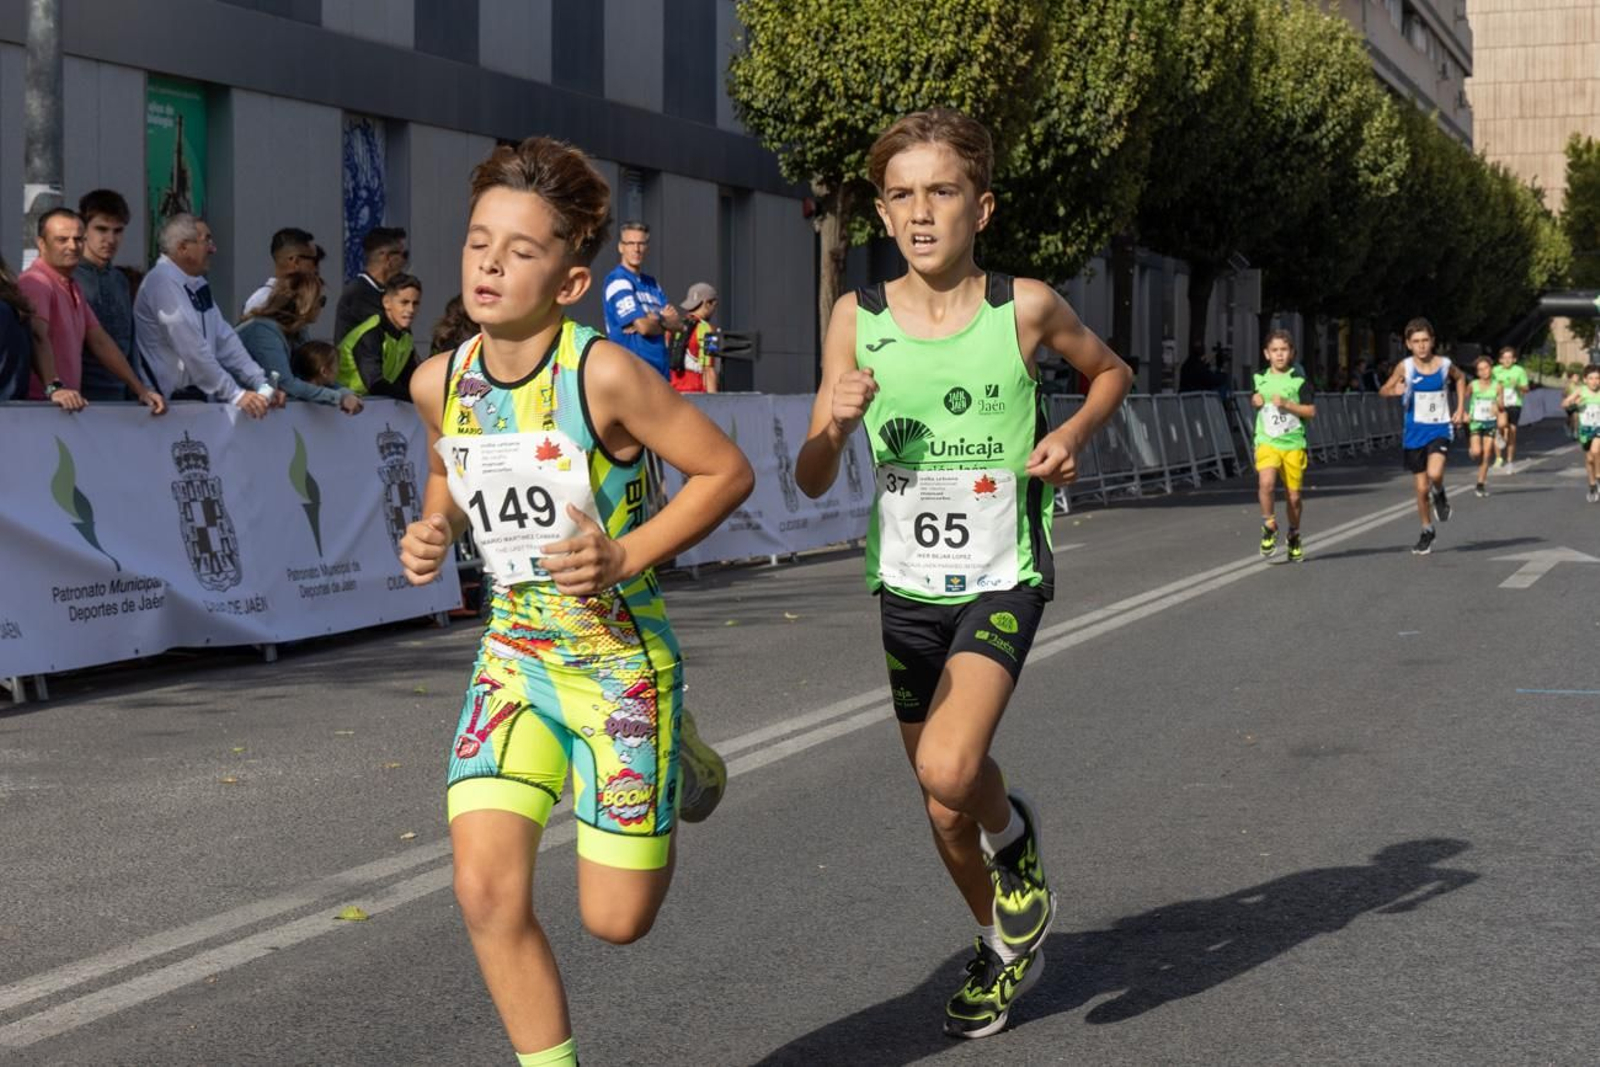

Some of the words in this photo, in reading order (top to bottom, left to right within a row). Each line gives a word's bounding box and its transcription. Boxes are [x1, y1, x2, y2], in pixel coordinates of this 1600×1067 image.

[978, 399, 1004, 412] Jaén
[930, 436, 1004, 459] Unicaja
[886, 473, 910, 496] 37
[468, 486, 556, 532] 149
[914, 512, 969, 549] 65
[287, 568, 320, 582] Patronato
[51, 582, 106, 603] Patronato
[68, 602, 118, 623] Deportes
[121, 598, 136, 615] de
